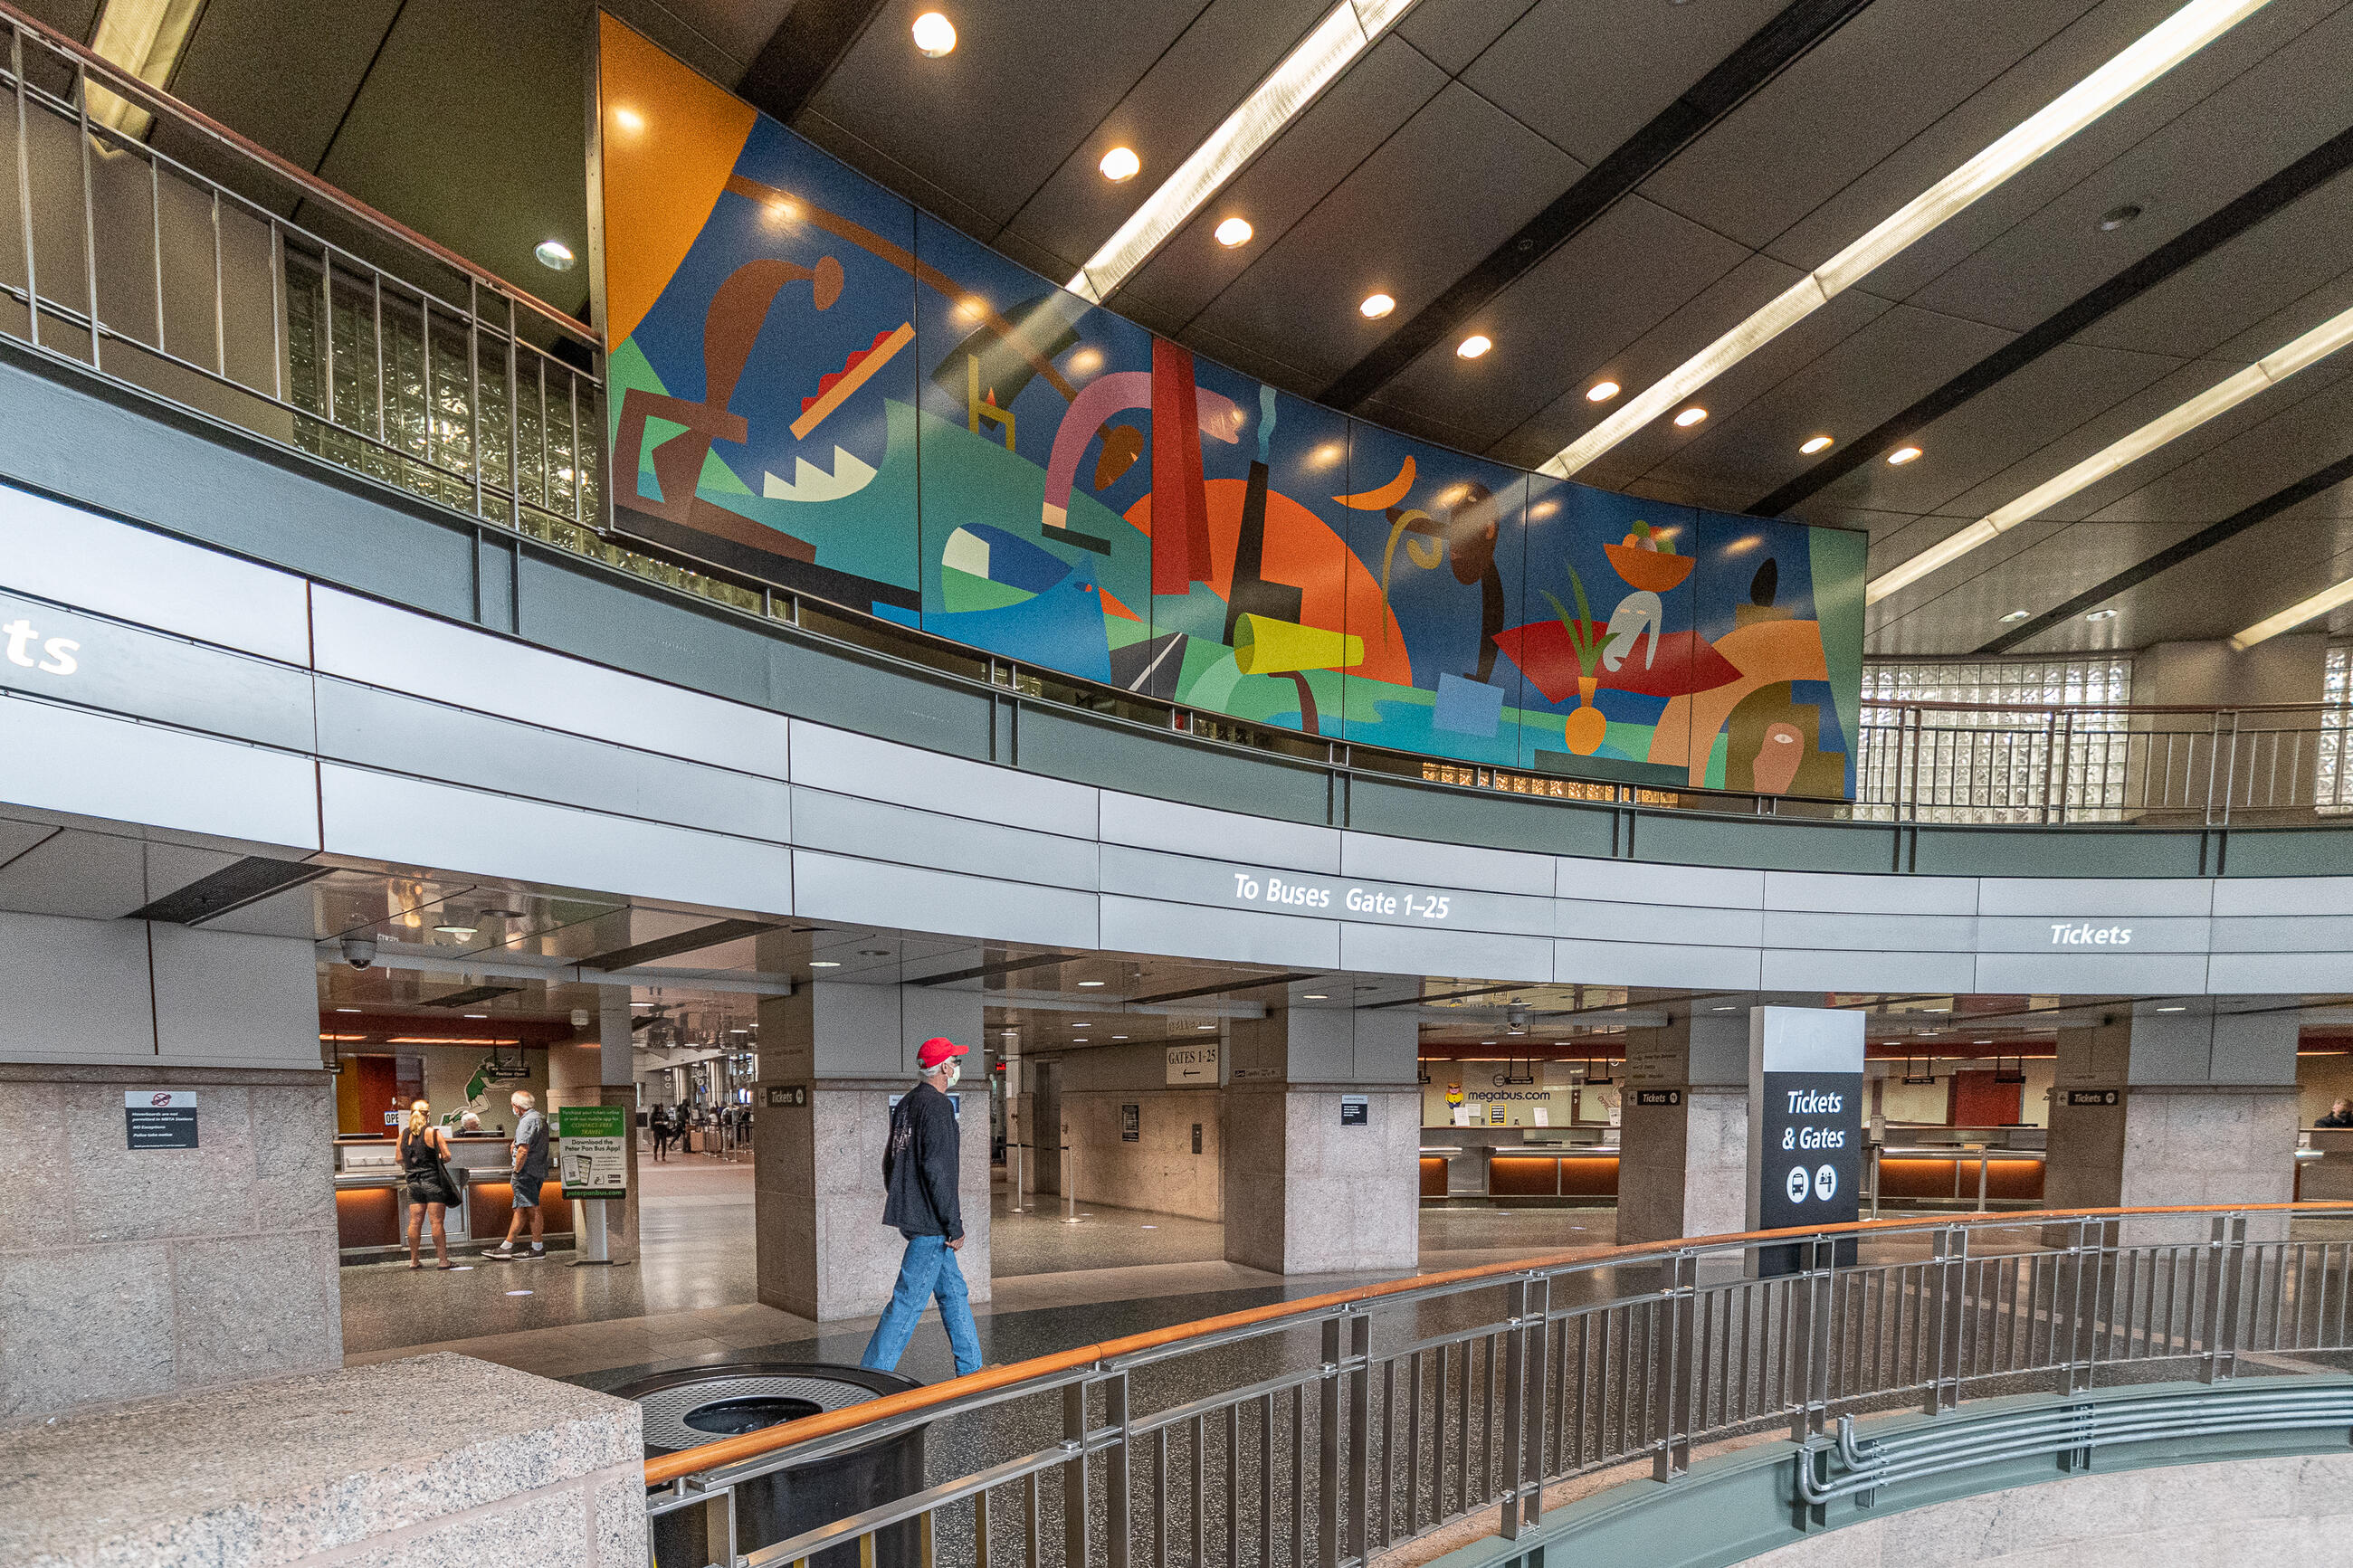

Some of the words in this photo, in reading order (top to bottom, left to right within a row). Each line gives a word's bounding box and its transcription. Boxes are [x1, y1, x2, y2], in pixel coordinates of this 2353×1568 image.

[2, 620, 80, 676] ts
[1234, 873, 1259, 900] To
[1266, 878, 1330, 908] Buses
[1346, 888, 1396, 915] Gate
[2051, 923, 2132, 945] Tickets
[1168, 1050, 1195, 1065] GATES
[771, 1089, 793, 1104] Tickets
[1468, 1089, 1550, 1103] megabus.com
[1643, 1093, 1666, 1103] Tickets
[1786, 1088, 1843, 1114] Tickets
[2074, 1093, 2101, 1103] Tickets
[1782, 1126, 1796, 1150] &
[1799, 1126, 1846, 1150] Gates
[566, 1189, 623, 1198] peterpanbus.com
